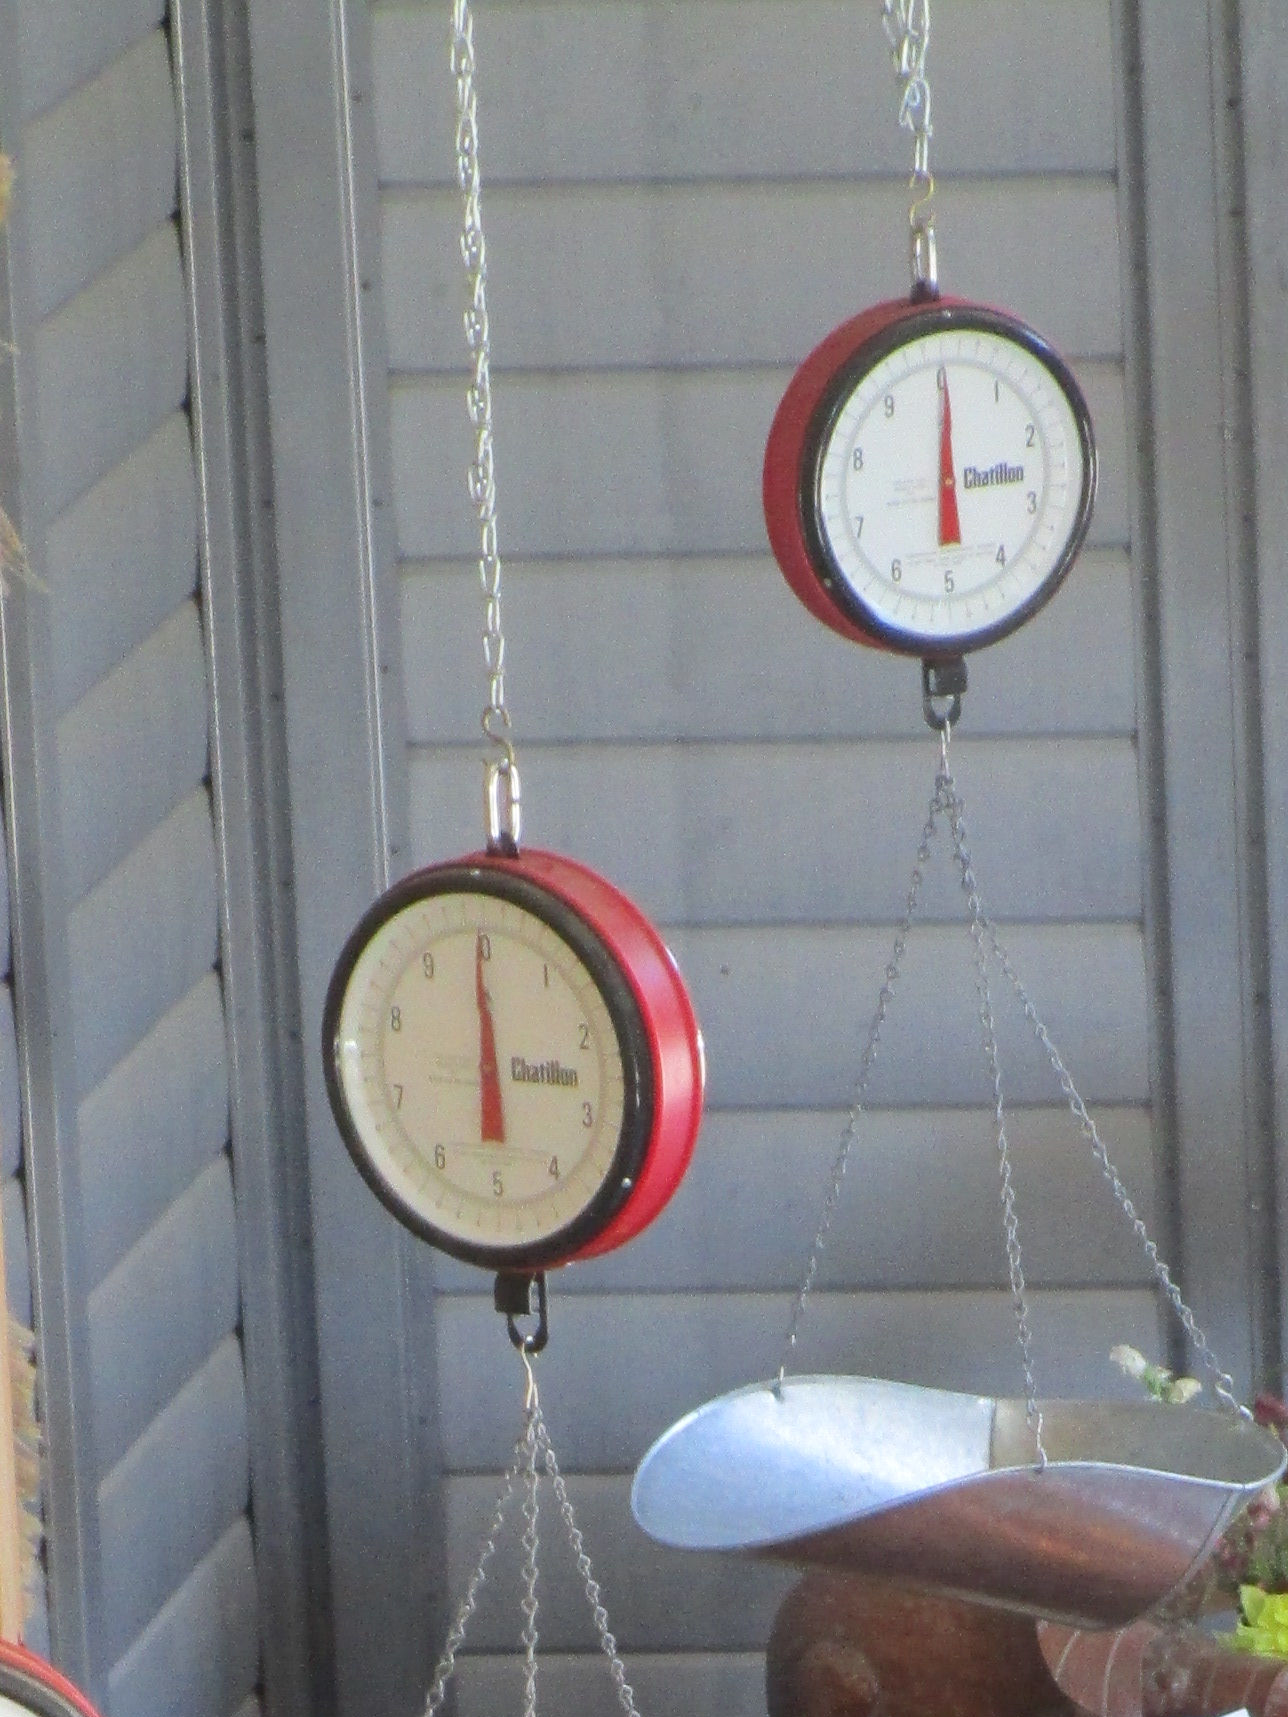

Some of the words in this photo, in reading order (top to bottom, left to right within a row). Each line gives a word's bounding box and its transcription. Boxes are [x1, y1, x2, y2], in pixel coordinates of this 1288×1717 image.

[936, 366, 946, 392] 0
[994, 379, 999, 403] 1
[884, 394, 895, 418] 9
[1025, 423, 1036, 448] 2
[853, 447, 863, 471] 8
[964, 462, 1025, 490] Chatillon
[1026, 491, 1037, 515] 3
[855, 516, 865, 539] 7
[996, 544, 1006, 568] 4
[891, 558, 902, 584] 6
[944, 570, 955, 594] 5
[478, 934, 491, 961] 0
[422, 952, 434, 979] 9
[543, 963, 549, 988] 1
[390, 1007, 401, 1032] 8
[578, 1023, 592, 1050] 2
[511, 1056, 579, 1088] Chatillon
[393, 1085, 404, 1109] 7
[582, 1102, 593, 1128] 3
[434, 1145, 446, 1170] 6
[548, 1155, 560, 1180] 4
[492, 1170, 504, 1196] 5
